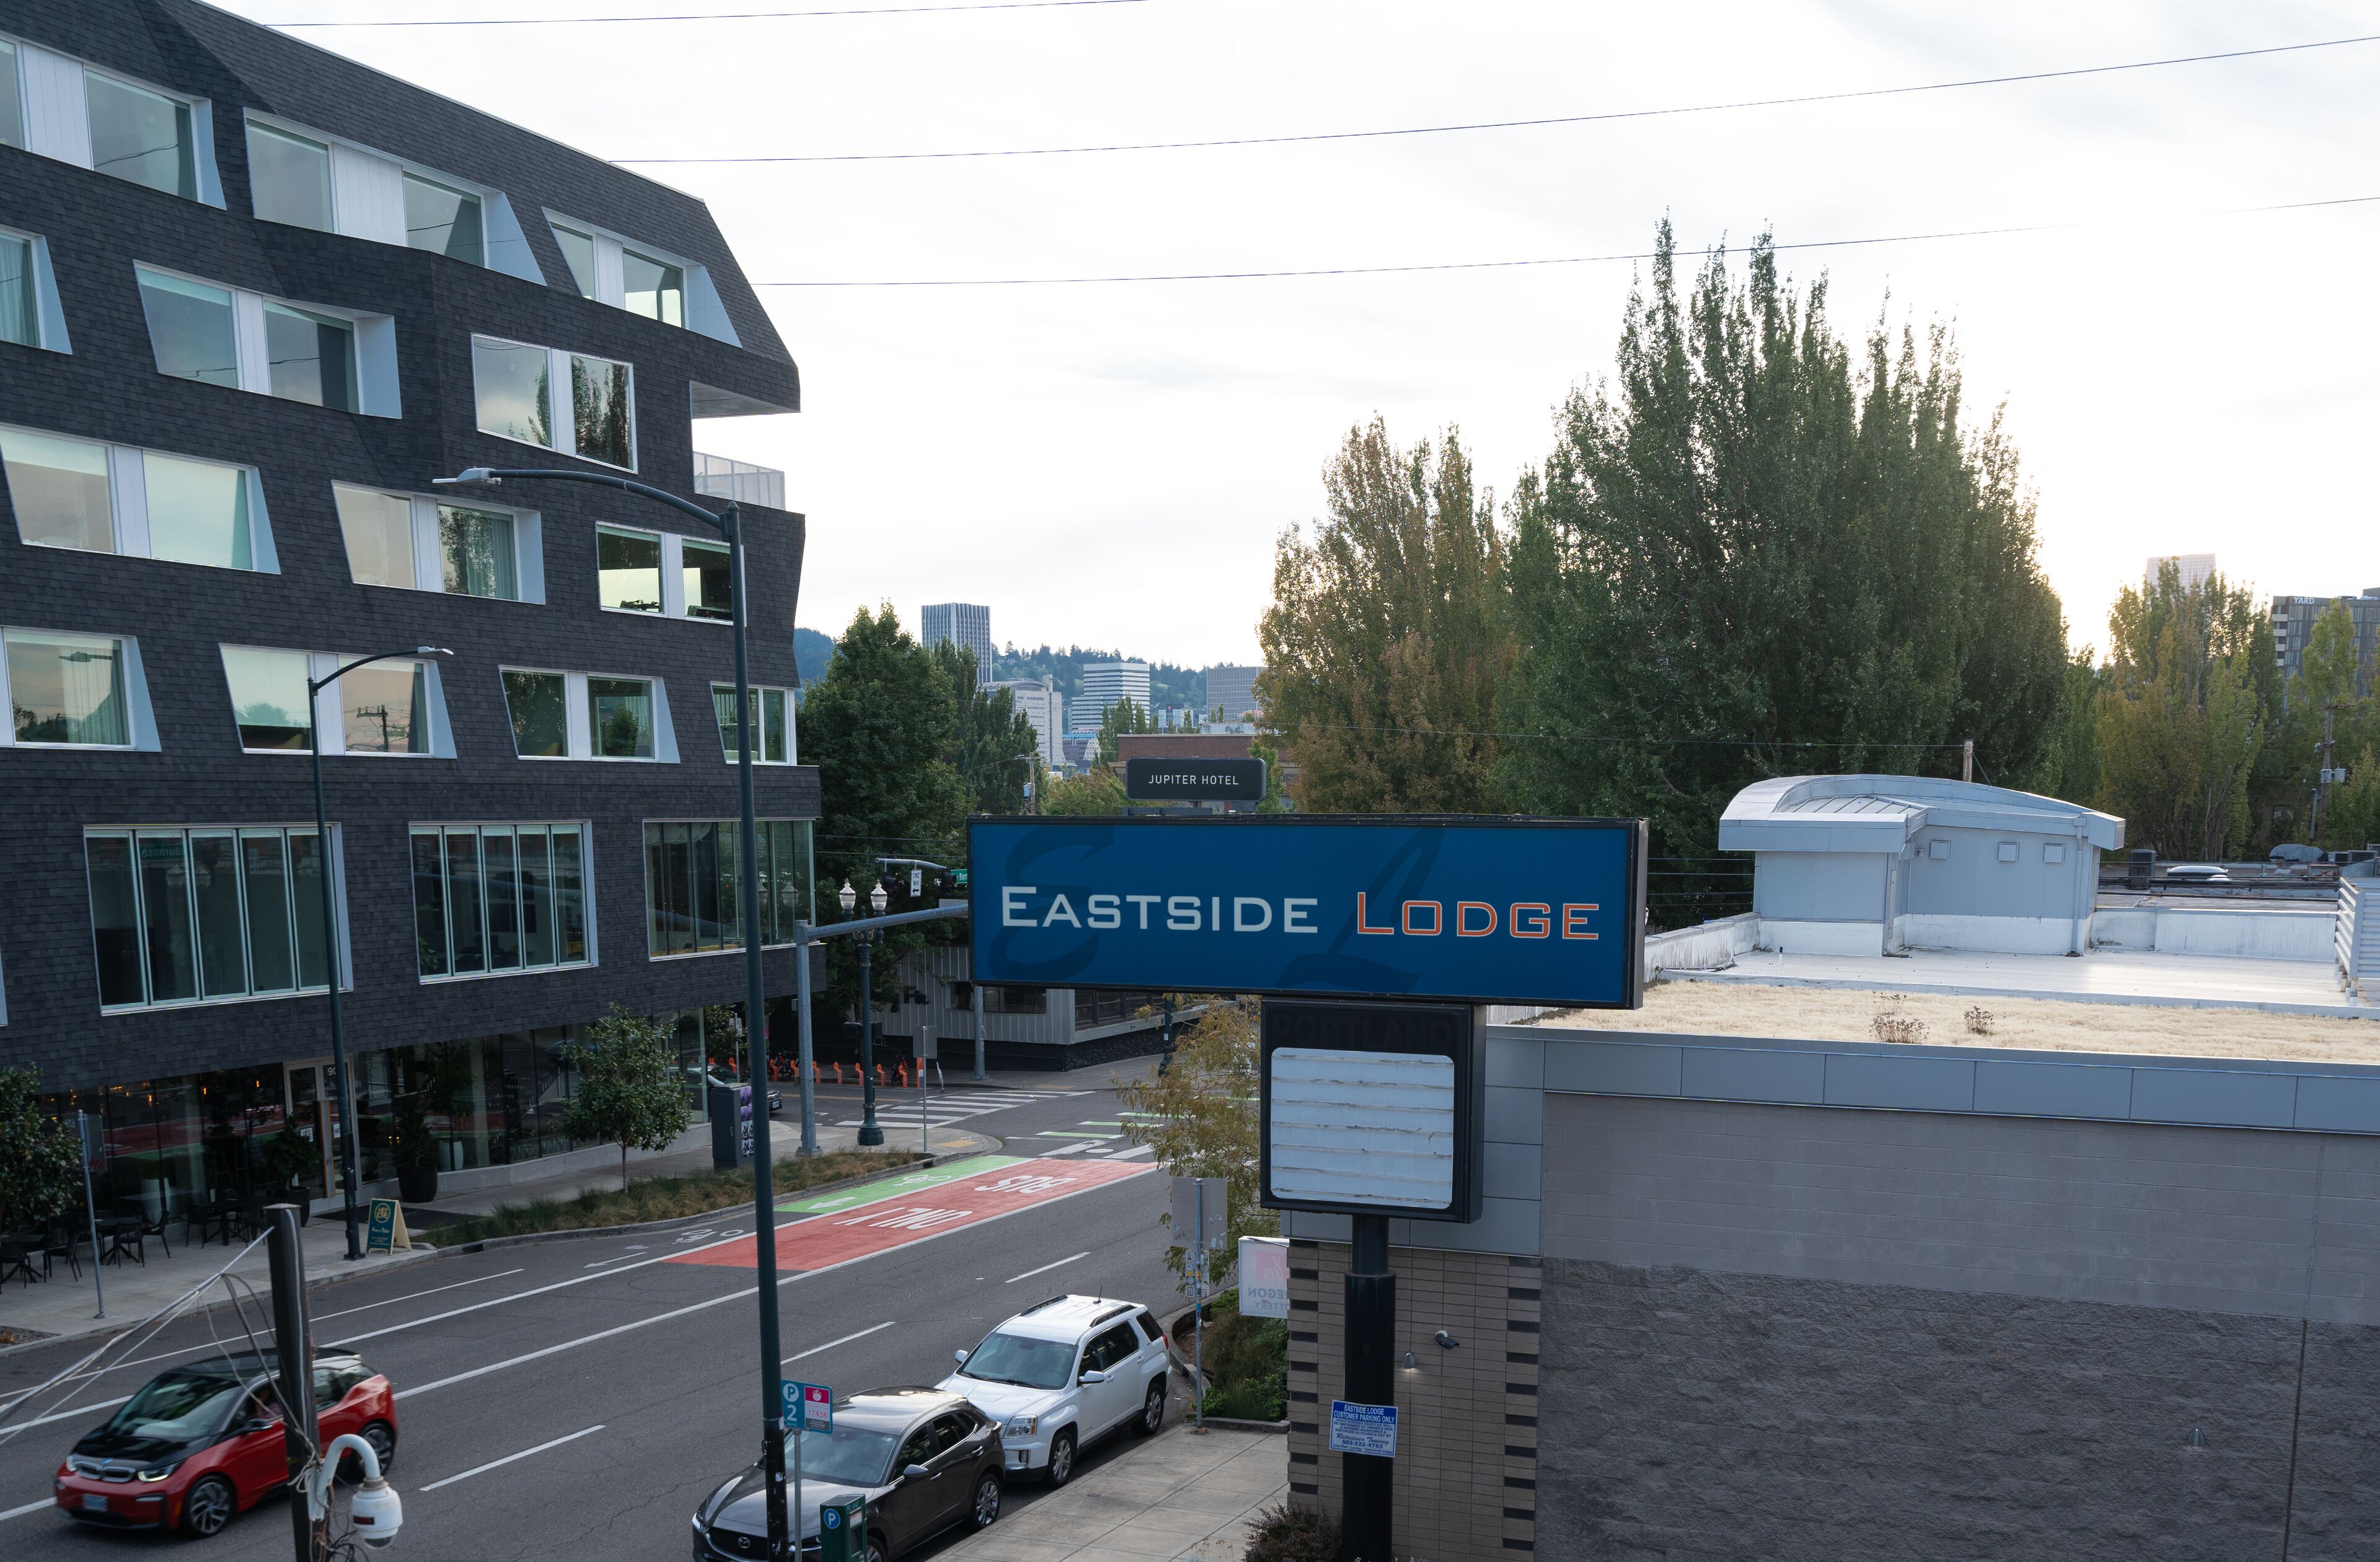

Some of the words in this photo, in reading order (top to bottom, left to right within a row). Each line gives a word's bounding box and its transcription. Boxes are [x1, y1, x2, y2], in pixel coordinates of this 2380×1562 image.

[1148, 775, 1196, 784] JUPITER
[1202, 776, 1239, 785] HOTEL
[1002, 885, 1318, 934] EASTSIDE
[1357, 892, 1600, 941] LODGE
[1274, 1014, 1453, 1051] PORTLAND
[974, 1175, 1079, 1194] BUS
[832, 1206, 973, 1229] ONLY
[787, 1385, 796, 1398] P
[787, 1404, 797, 1421] 2
[808, 1410, 827, 1418] 11438
[1334, 1410, 1359, 1420] CUSTOMER
[1359, 1415, 1380, 1423] PARKING
[1344, 1405, 1367, 1413] EASTSIDE
[1367, 1407, 1384, 1415] LODGE
[1336, 1433, 1365, 1441] Retriever
[1367, 1437, 1389, 1446] Towing
[1342, 1439, 1383, 1449] 503-222-4763
[828, 1512, 835, 1525] P
